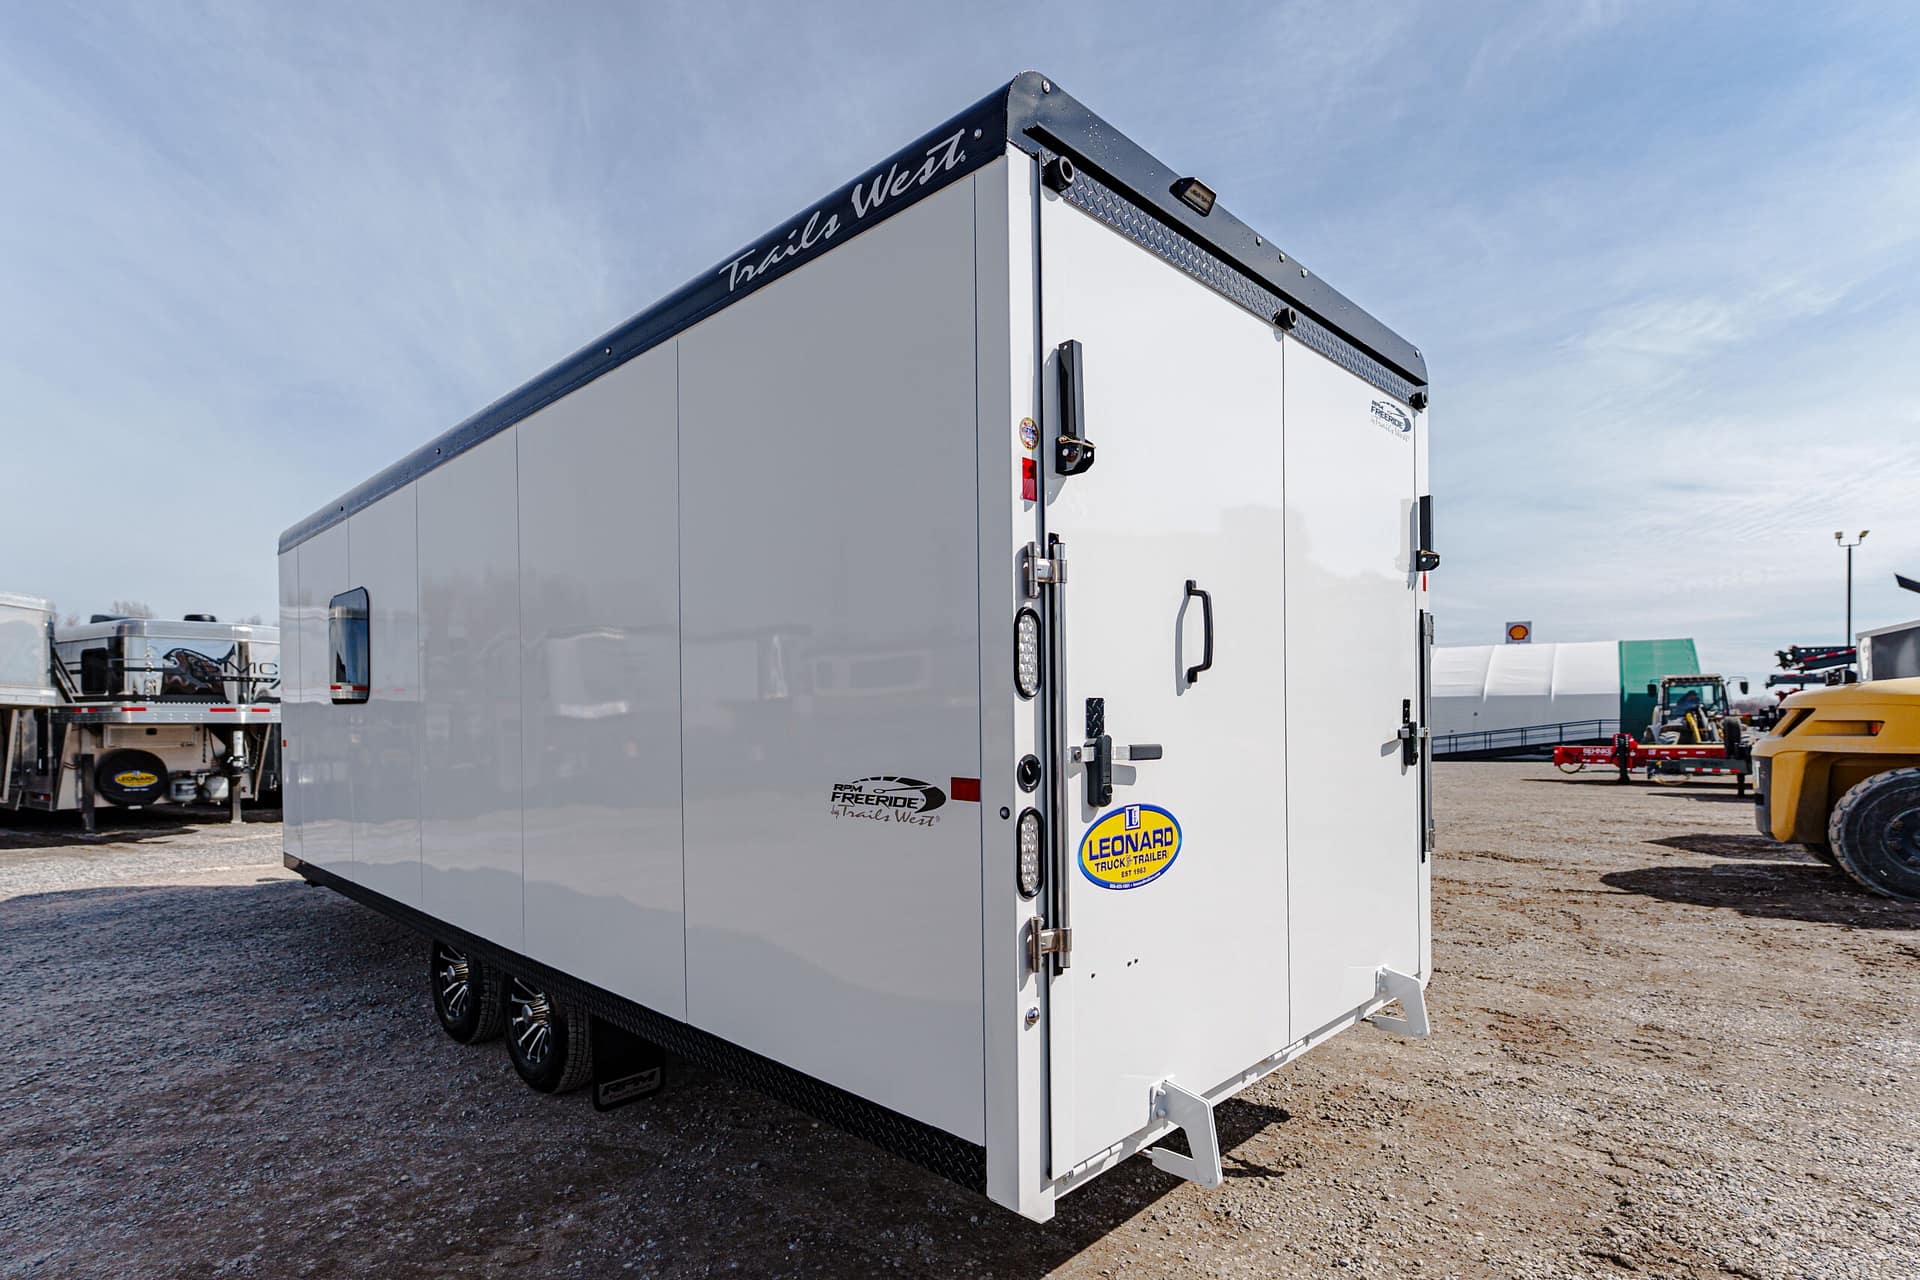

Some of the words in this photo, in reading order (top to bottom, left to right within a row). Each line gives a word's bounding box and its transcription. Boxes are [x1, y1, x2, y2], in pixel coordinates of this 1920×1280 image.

[719, 211, 840, 292] Trails
[851, 128, 966, 218] West
[1370, 405, 1404, 430] FREERIDE
[833, 783, 863, 793] RPM
[831, 792, 919, 810] FREERIDE
[838, 804, 890, 821] Trails
[895, 809, 935, 827] West
[1088, 827, 1174, 860] LEONARD
[1094, 859, 1126, 873] TRUCK
[1133, 850, 1168, 865] TRAILER
[1121, 869, 1132, 878] EST
